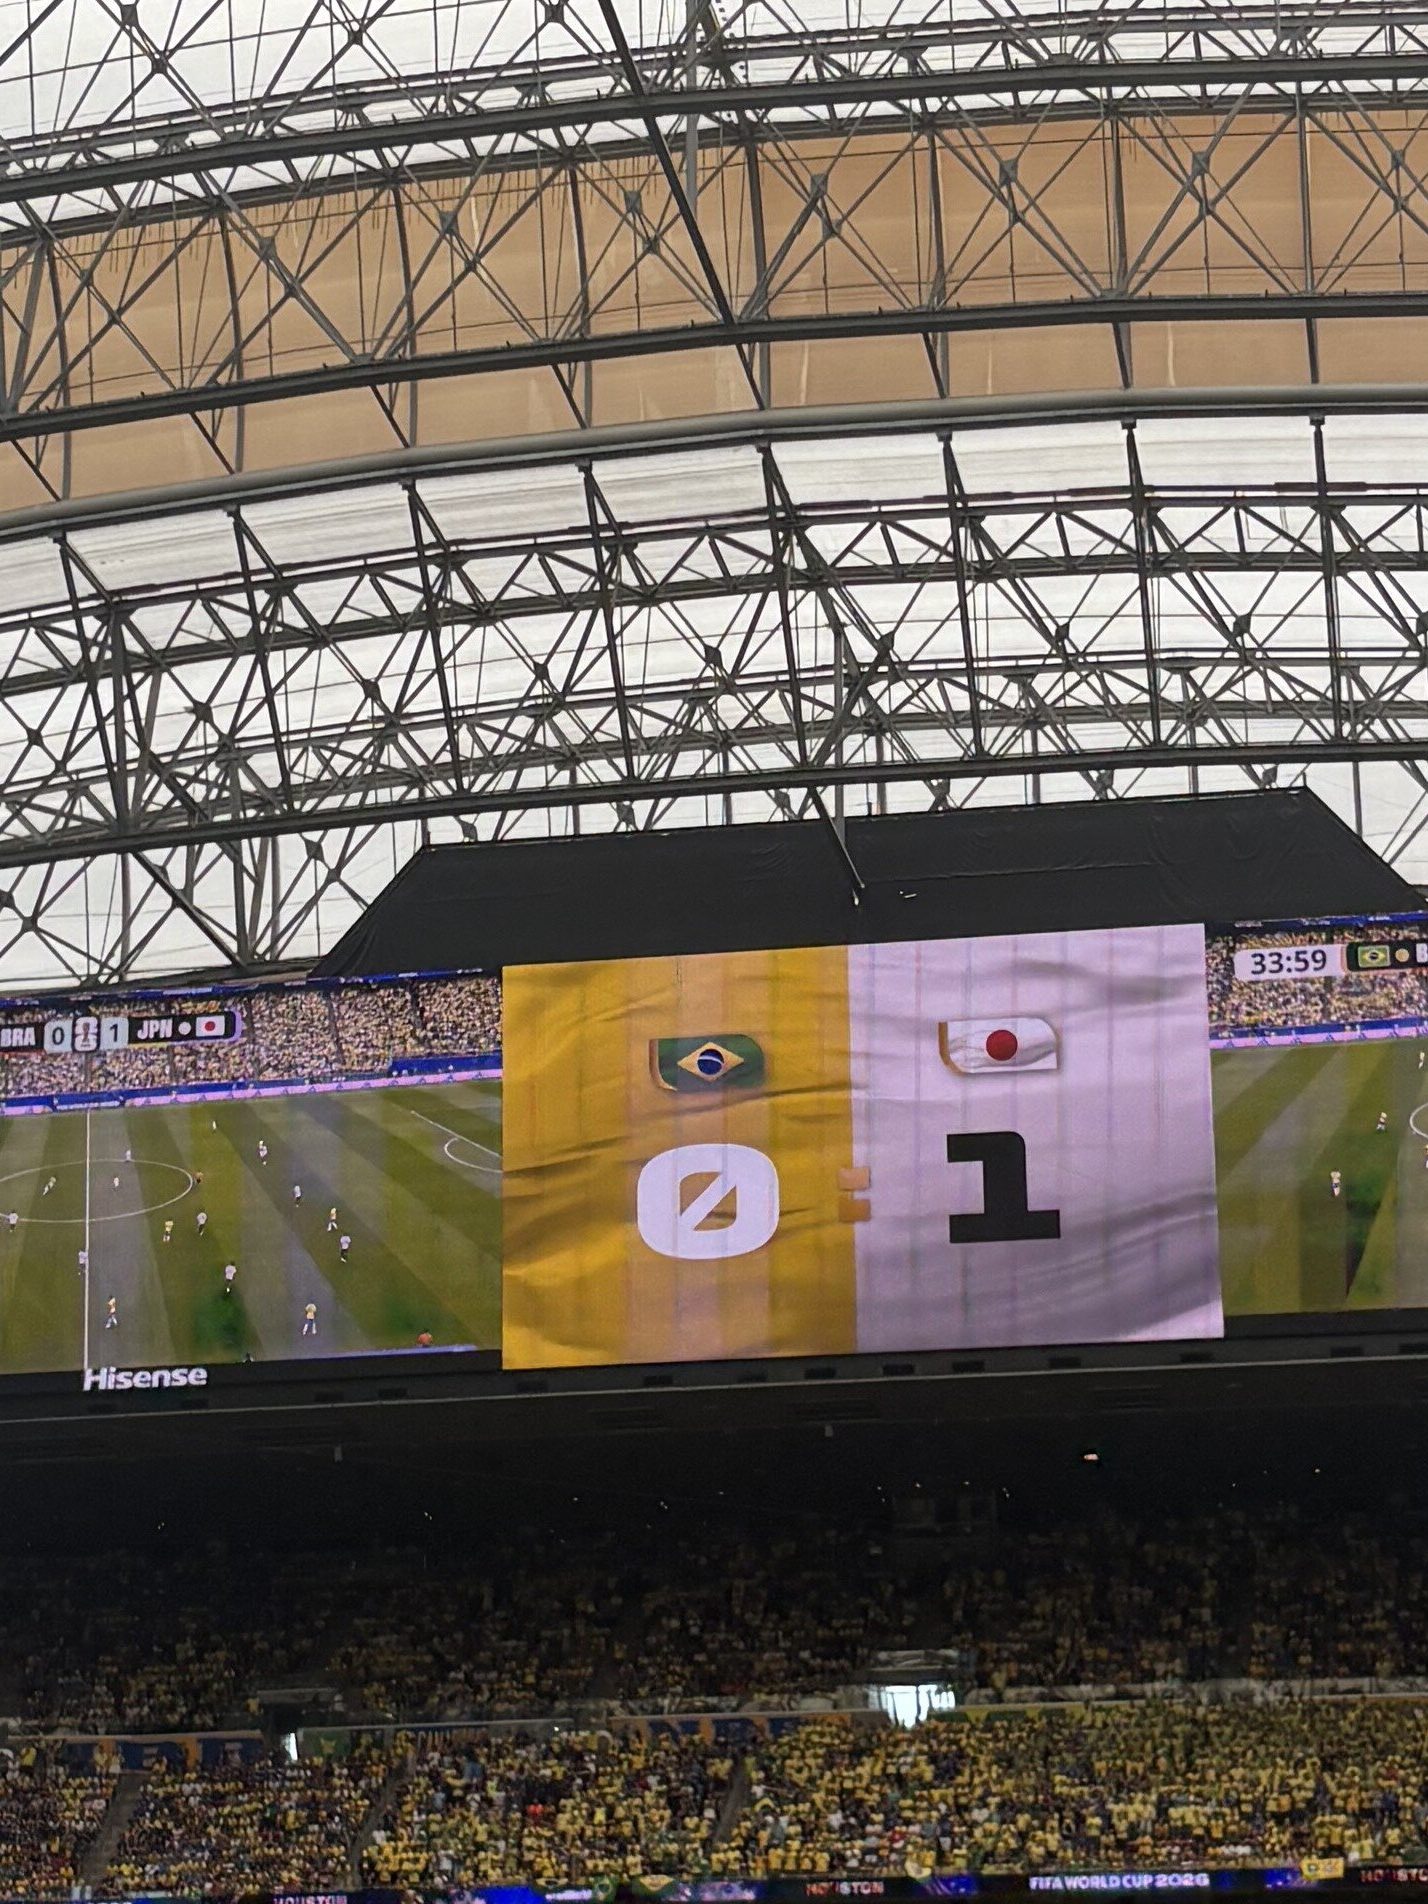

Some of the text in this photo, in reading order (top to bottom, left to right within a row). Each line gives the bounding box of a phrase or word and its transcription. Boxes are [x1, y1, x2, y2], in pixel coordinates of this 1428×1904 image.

[1250, 949, 1328, 976] 33:59
[0, 1026, 36, 1048] BRA
[52, 1027, 63, 1046] 0
[109, 1024, 119, 1043] 1
[136, 1019, 174, 1041] JPN
[946, 1130, 1061, 1244] 1
[636, 1143, 780, 1260] 0
[83, 1367, 208, 1391] Hisense
[1029, 1873, 1210, 1892] FIFA WORLD CUP 2026
